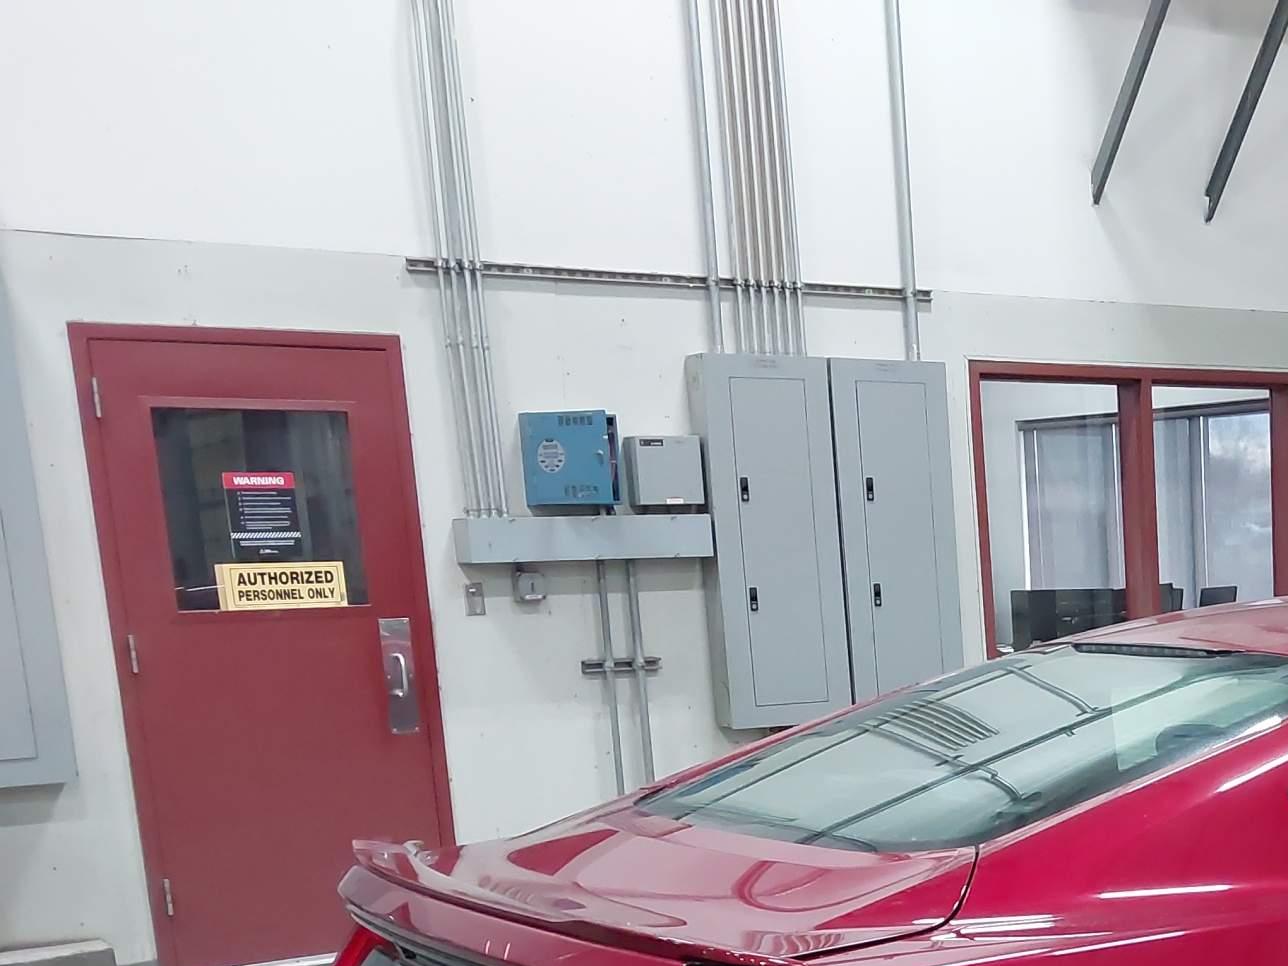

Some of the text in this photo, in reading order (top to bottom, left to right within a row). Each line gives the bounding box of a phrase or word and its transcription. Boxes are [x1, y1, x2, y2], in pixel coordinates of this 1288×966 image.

[233, 476, 284, 486] WARNING
[237, 571, 334, 586] AUTHORIZED
[238, 588, 335, 601] PERSONNEL ONLY
